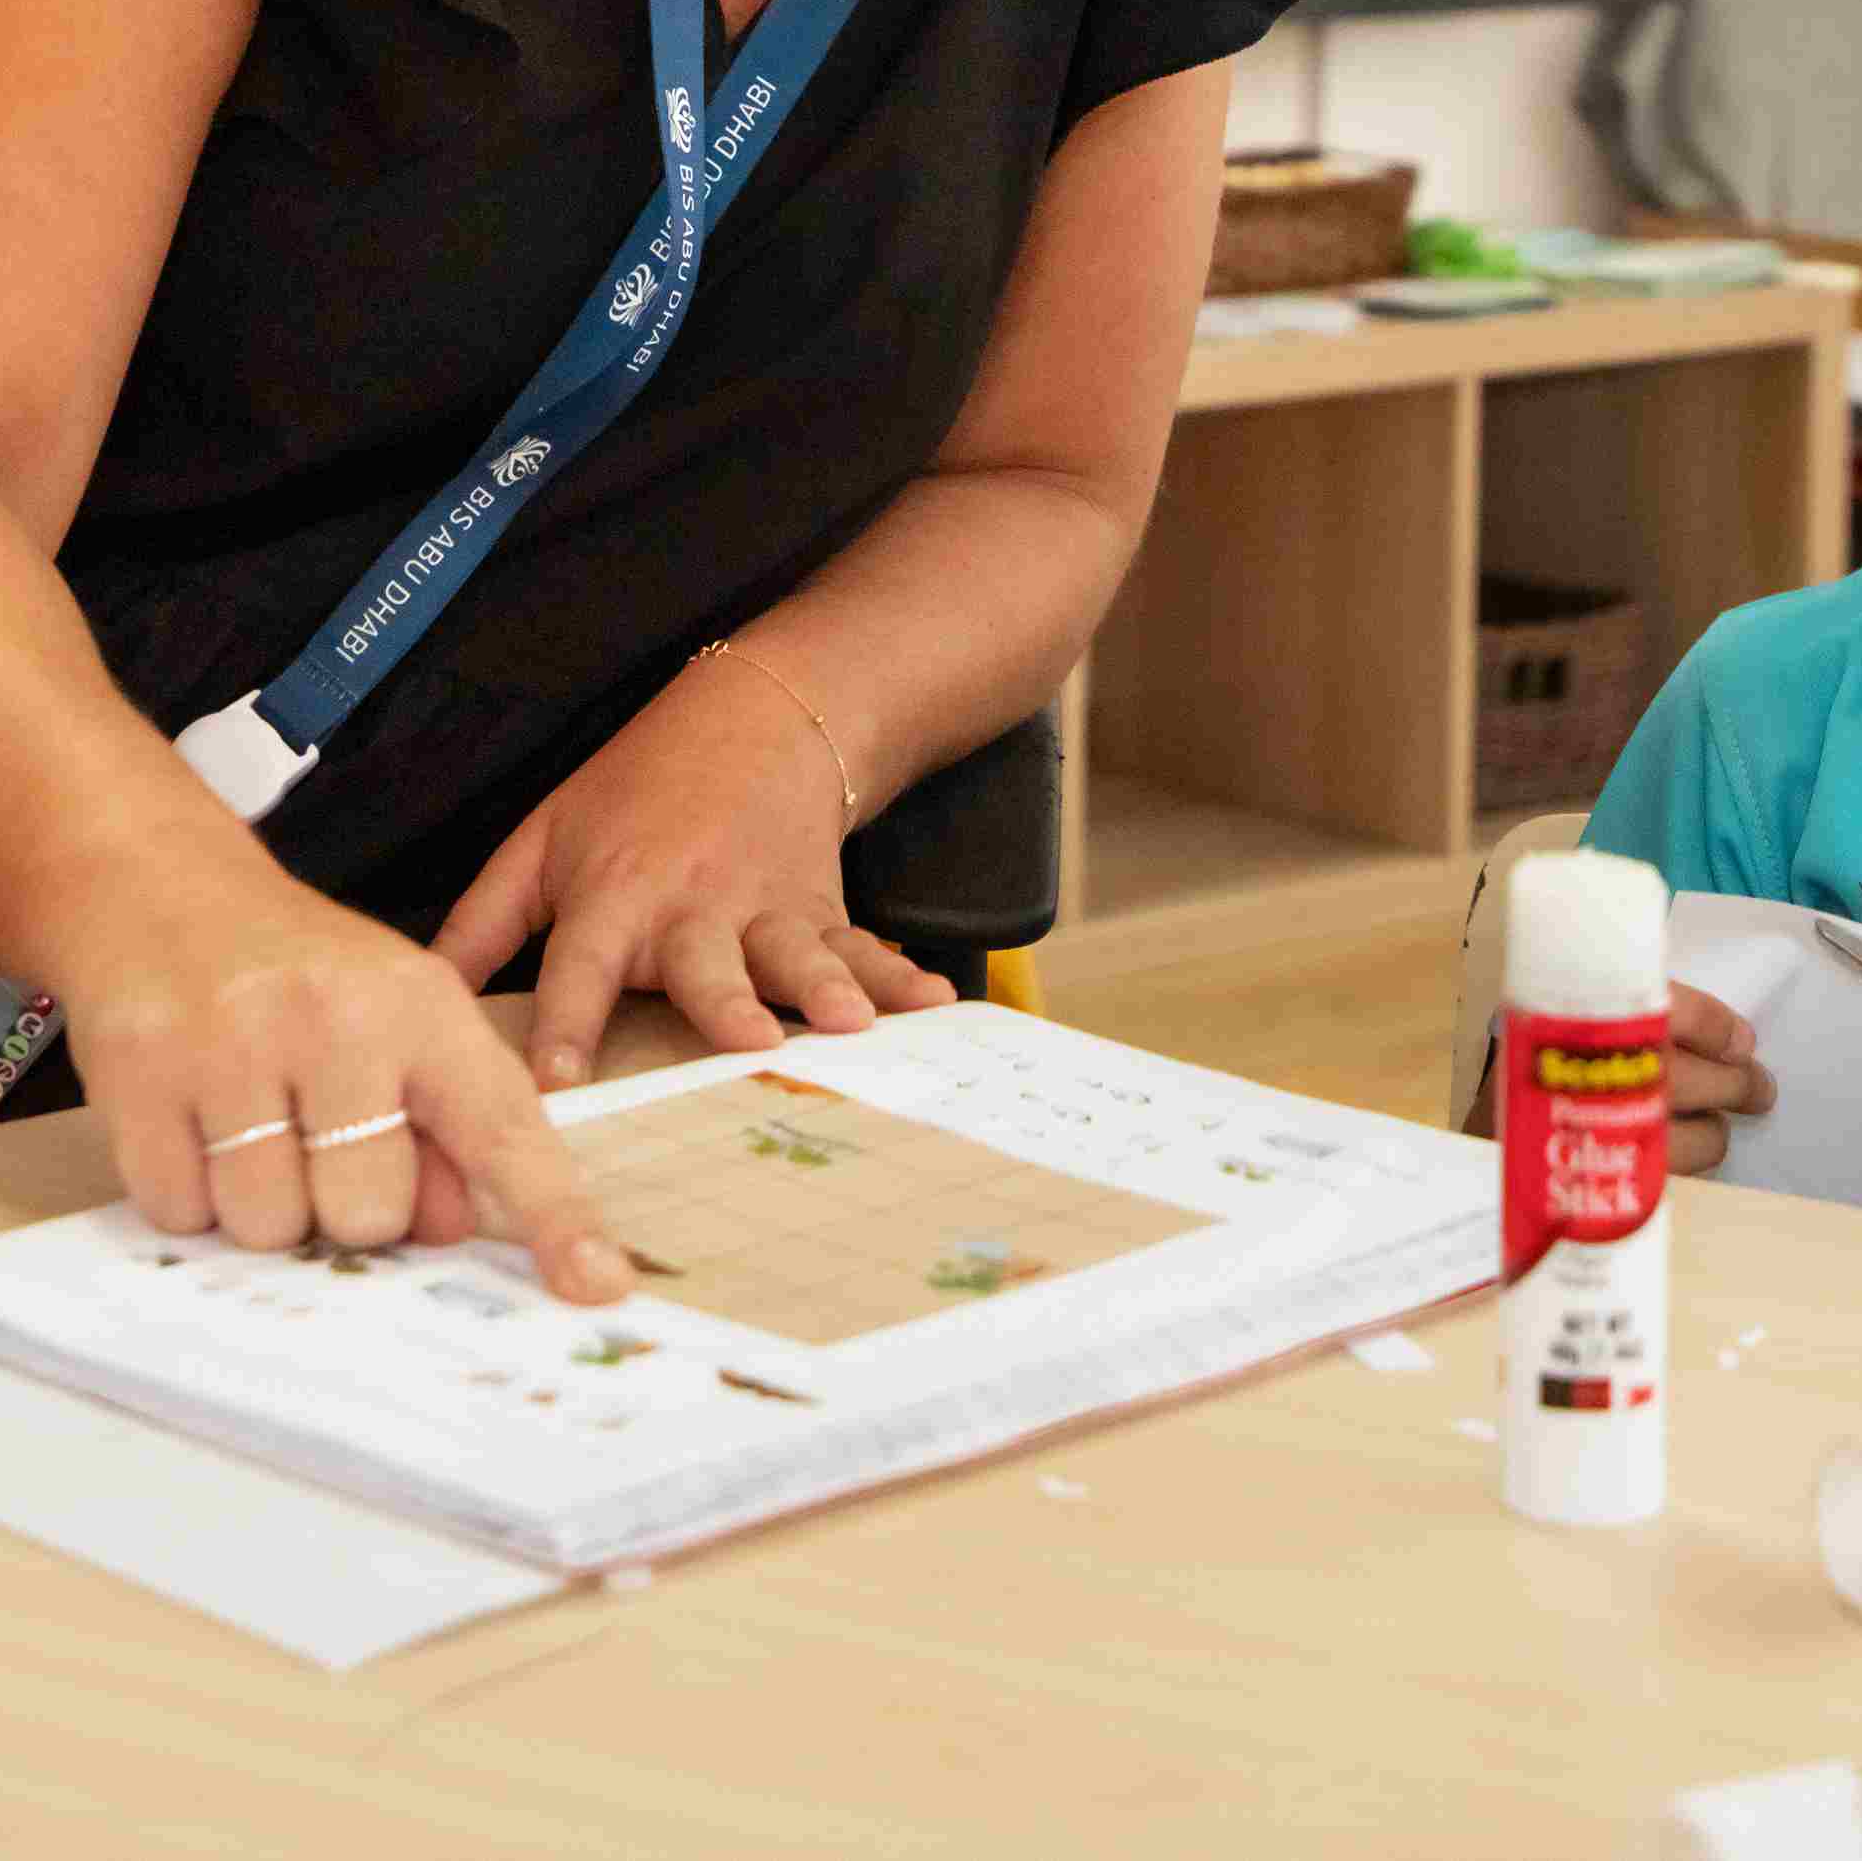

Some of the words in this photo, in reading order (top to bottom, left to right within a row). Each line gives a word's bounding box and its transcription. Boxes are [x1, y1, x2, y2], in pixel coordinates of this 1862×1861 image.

[714, 74, 777, 158] DHABI
[679, 164, 695, 212] BIS
[677, 218, 695, 282] ABU
[626, 290, 683, 372] DHABI
[449, 485, 496, 532] BIS
[403, 523, 458, 588] ABU
[335, 577, 412, 664] DHABI
[1546, 1130, 1638, 1172] Glue
[1547, 1169, 1641, 1214] Stick
